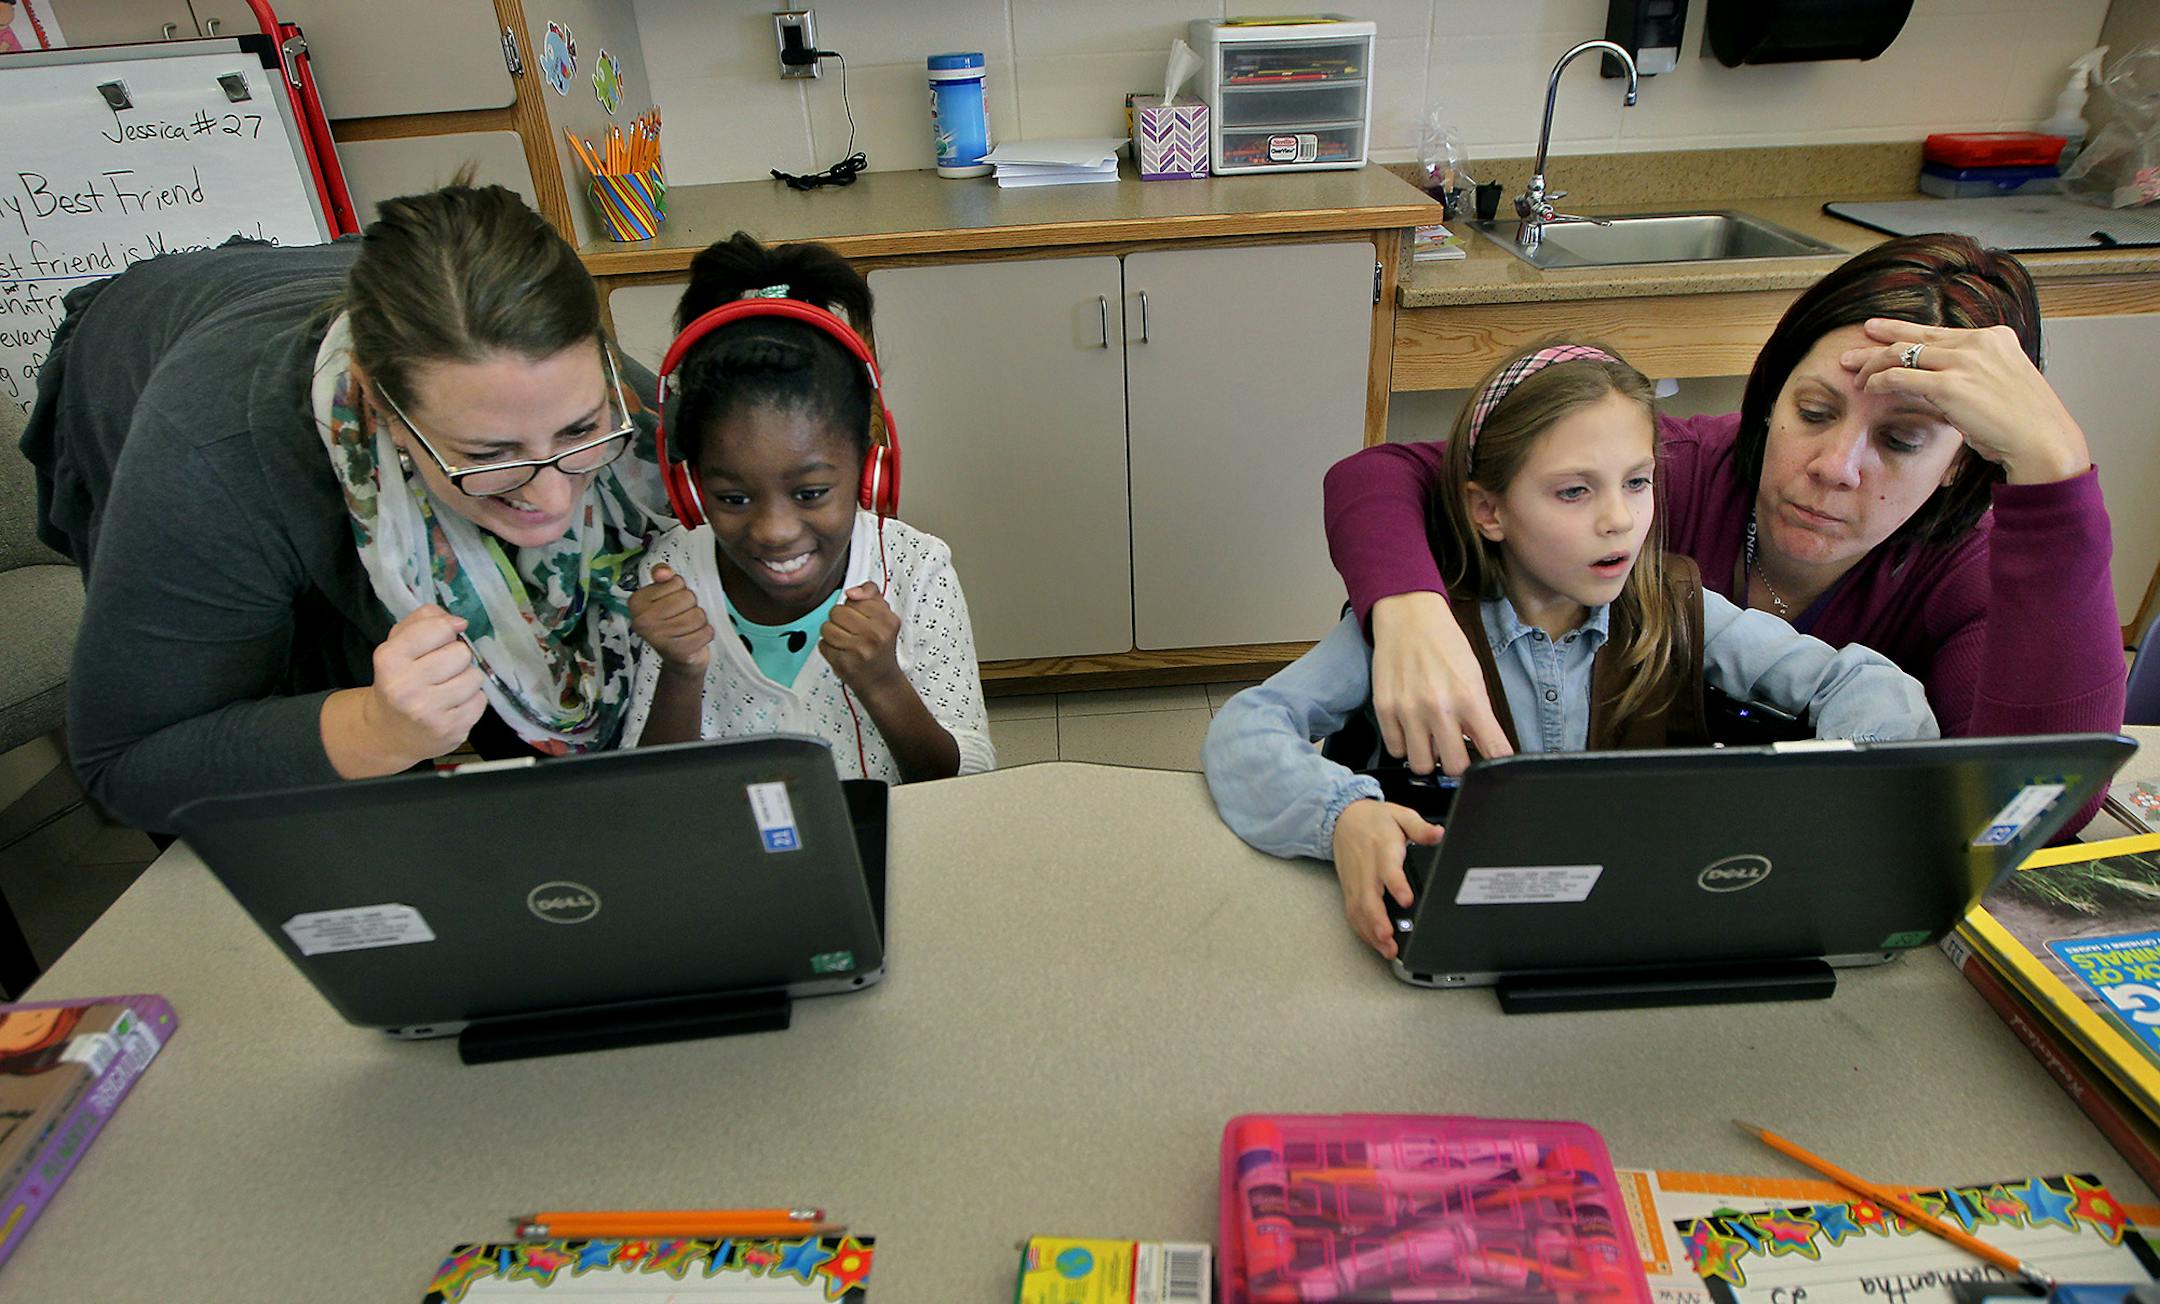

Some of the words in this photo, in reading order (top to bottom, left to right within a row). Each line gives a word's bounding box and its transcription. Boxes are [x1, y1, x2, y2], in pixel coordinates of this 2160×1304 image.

[102, 110, 189, 143] Jessica
[18, 171, 104, 217] Best
[102, 164, 204, 215] Friend
[30, 240, 116, 276] friend
[120, 243, 143, 268] is
[1706, 867, 1762, 880] DELL
[536, 895, 593, 911] DELL
[2089, 968, 2124, 985] OF
